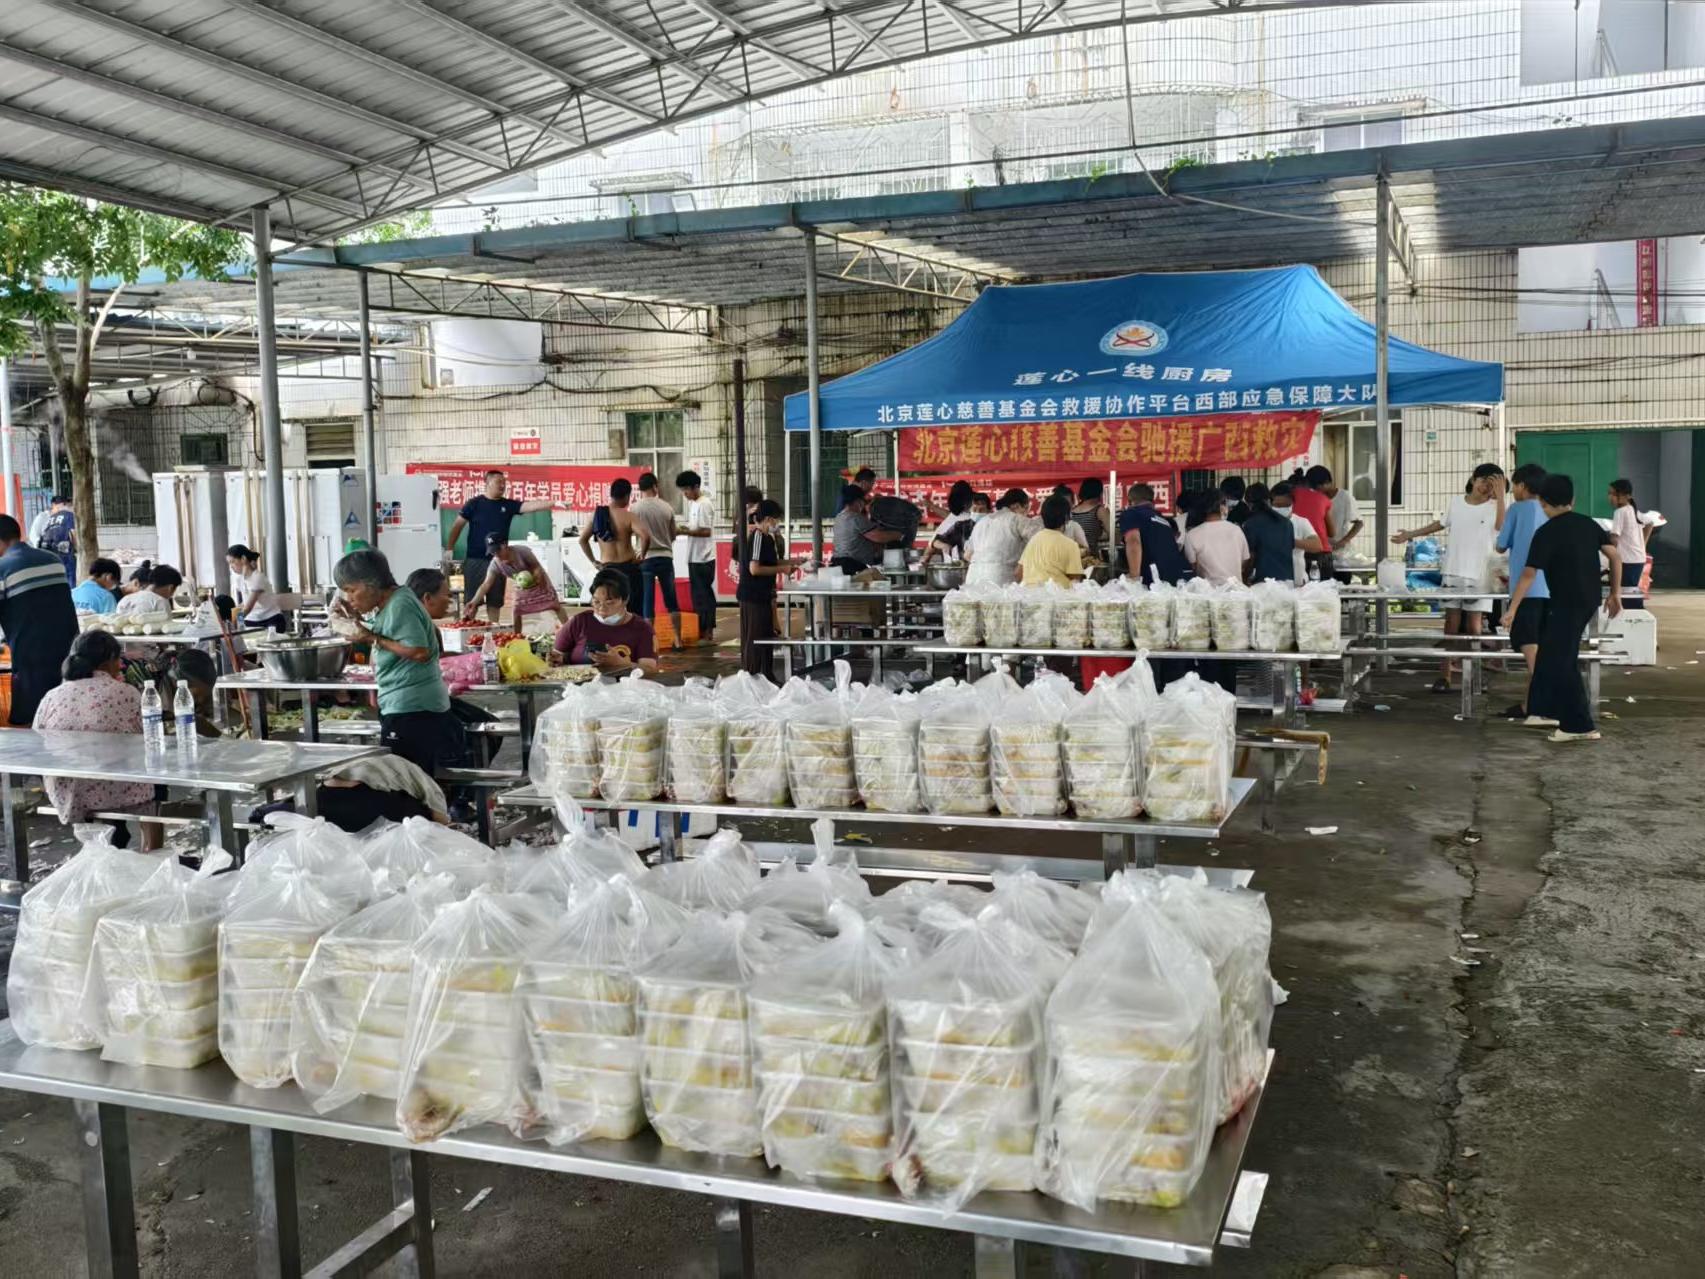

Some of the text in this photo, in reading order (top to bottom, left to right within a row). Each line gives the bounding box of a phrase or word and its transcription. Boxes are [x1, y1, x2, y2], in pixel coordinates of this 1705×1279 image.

[1012, 362, 1233, 386] 莲心一线厨房
[877, 383, 1377, 424] 北京莲心慈善基金会救援协作平台西部应急保障大队
[912, 416, 1307, 465] 北京莲心慈善基金会驰援广西救灾
